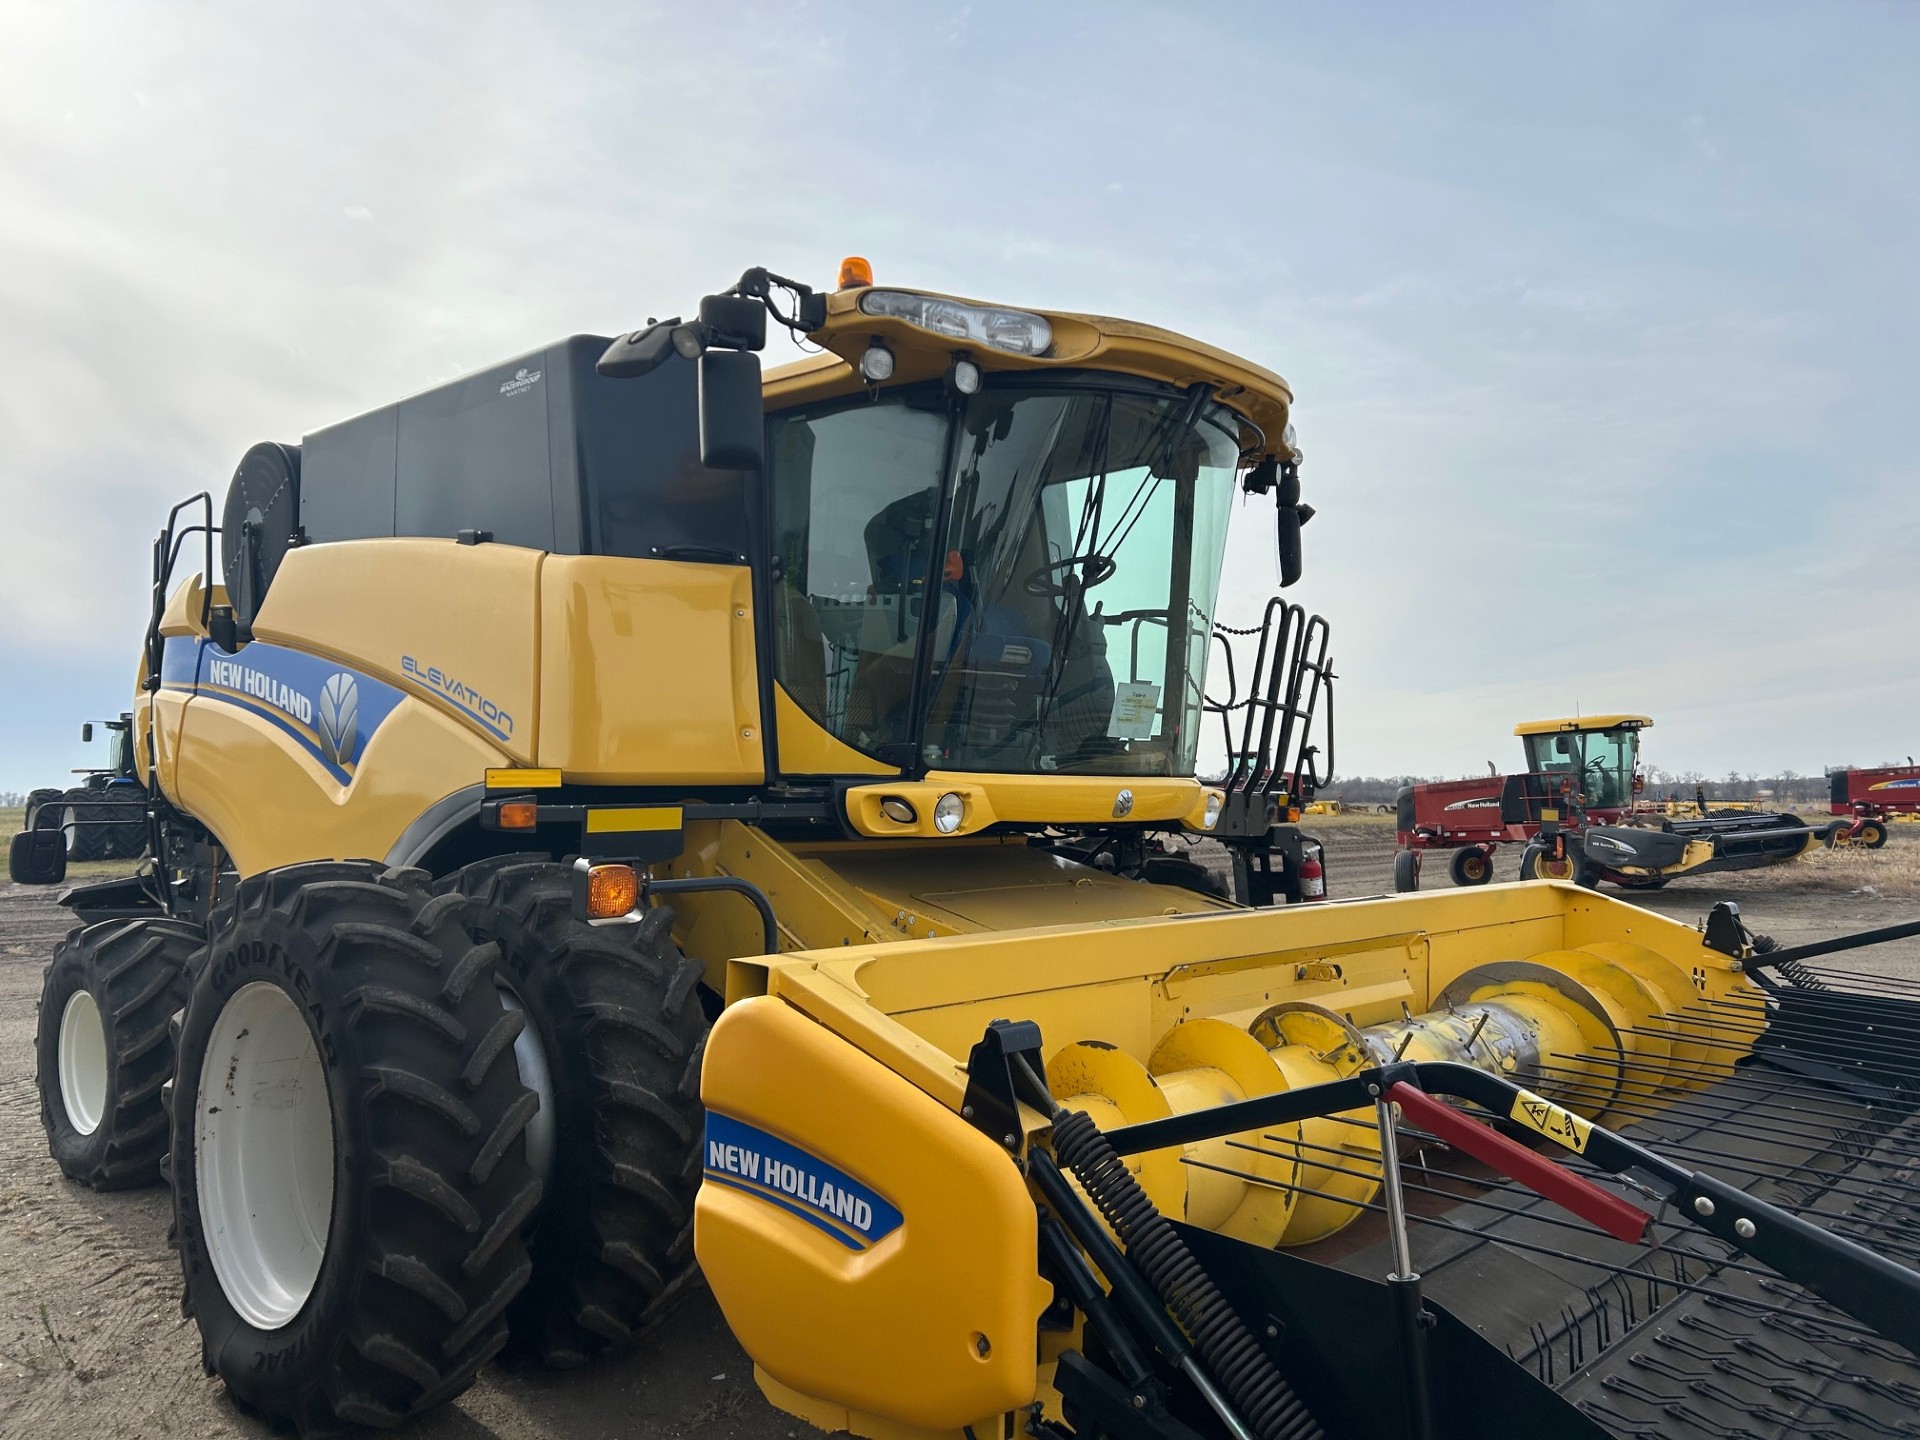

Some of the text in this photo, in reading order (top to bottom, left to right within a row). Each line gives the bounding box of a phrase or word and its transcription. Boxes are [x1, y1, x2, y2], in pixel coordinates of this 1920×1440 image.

[210, 659, 312, 725] NEW HOLLAND
[401, 655, 513, 734] ELEVATION
[211, 940, 339, 1071] GOODYEAR
[709, 1140, 872, 1231] NEW HOLLAND
